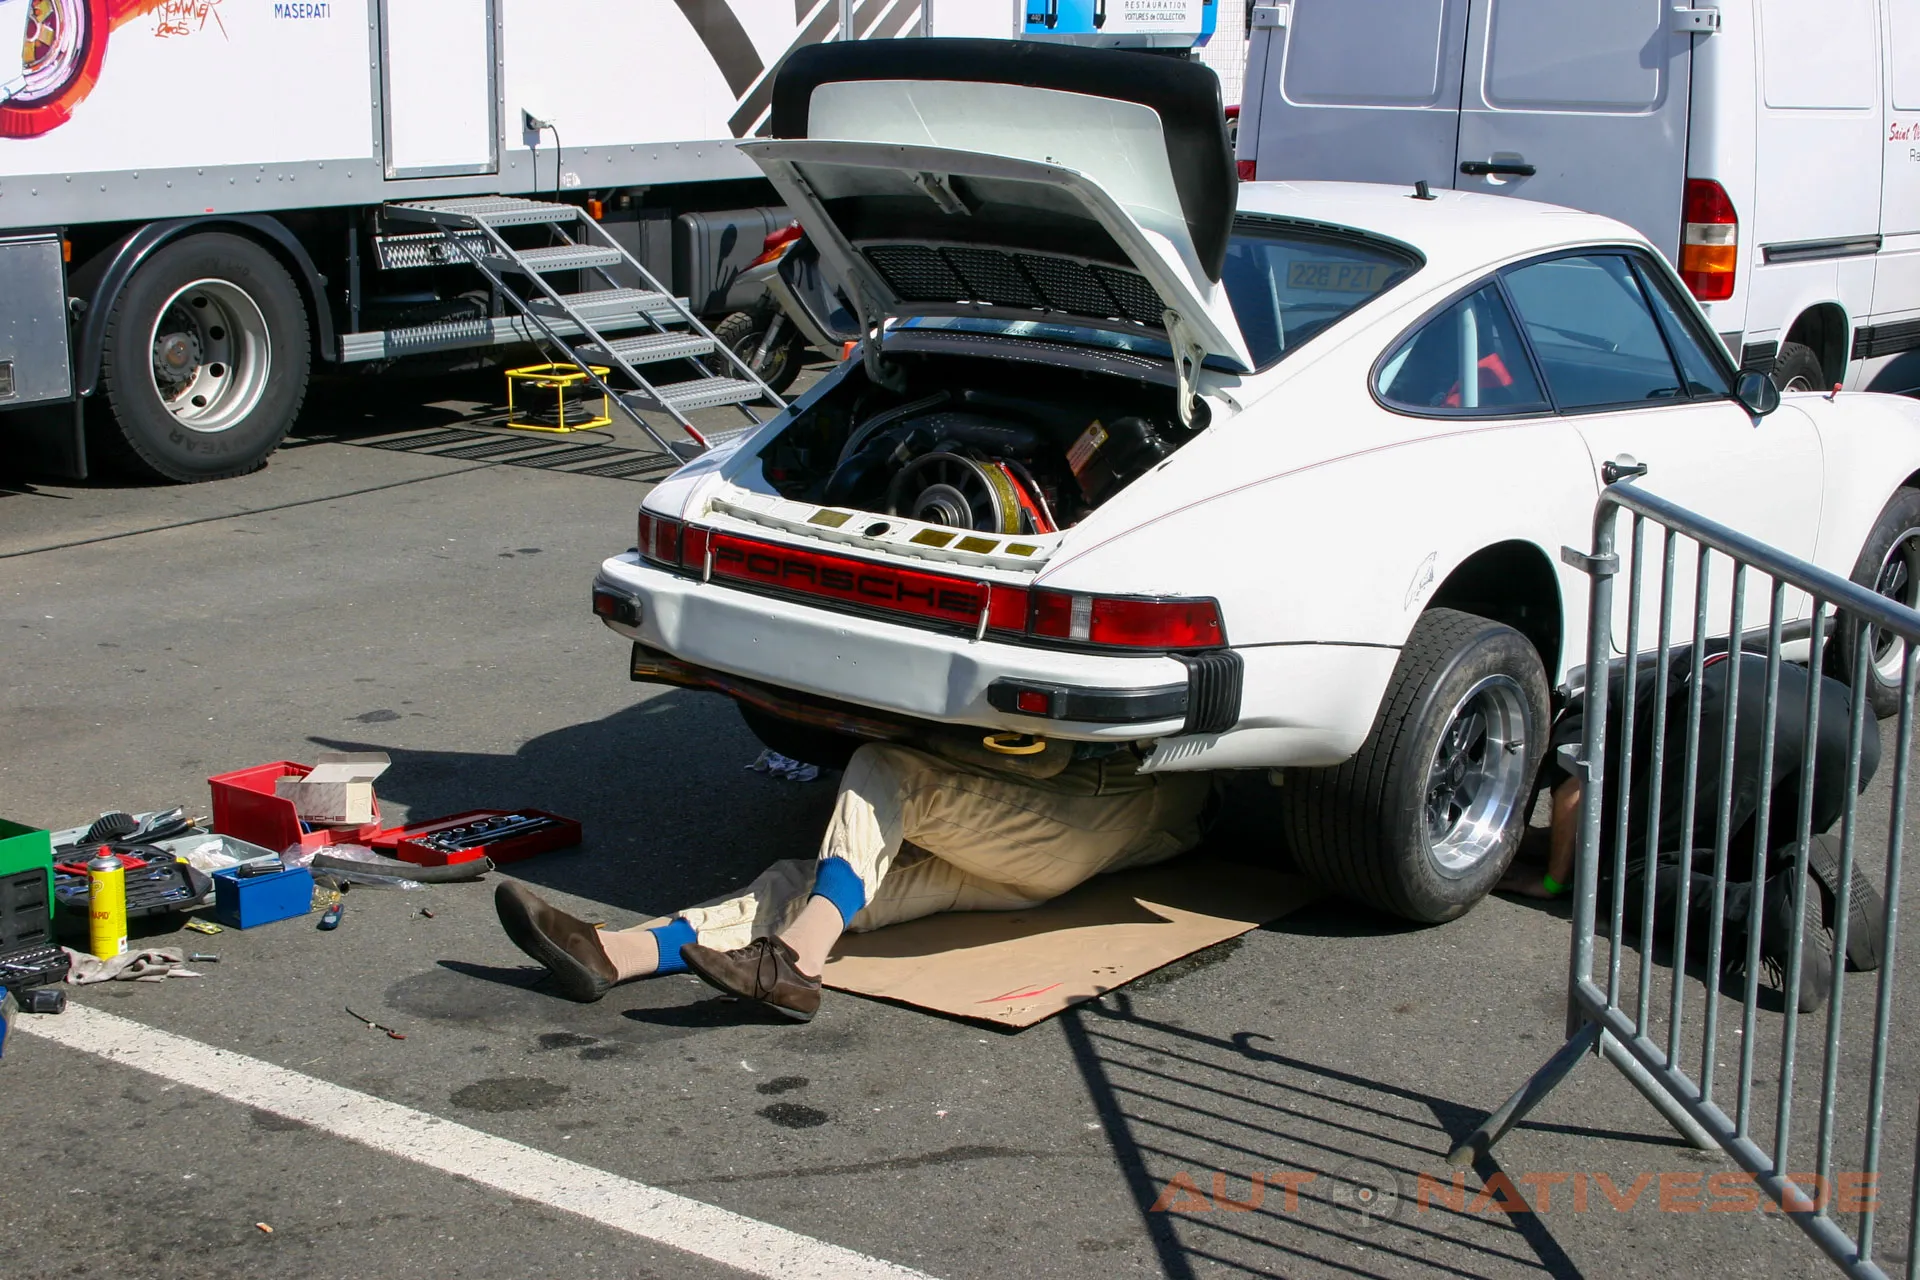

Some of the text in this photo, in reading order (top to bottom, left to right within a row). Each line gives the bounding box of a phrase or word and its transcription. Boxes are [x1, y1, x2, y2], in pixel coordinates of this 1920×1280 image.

[274, 3, 331, 19] MASERATI
[1124, 1, 1187, 9] RESTAURATION
[1124, 12, 1149, 21] VOITURES
[1156, 12, 1186, 21] COLLECTION
[1889, 122, 1910, 141] Saint
[715, 547, 979, 614] PORSCHE
